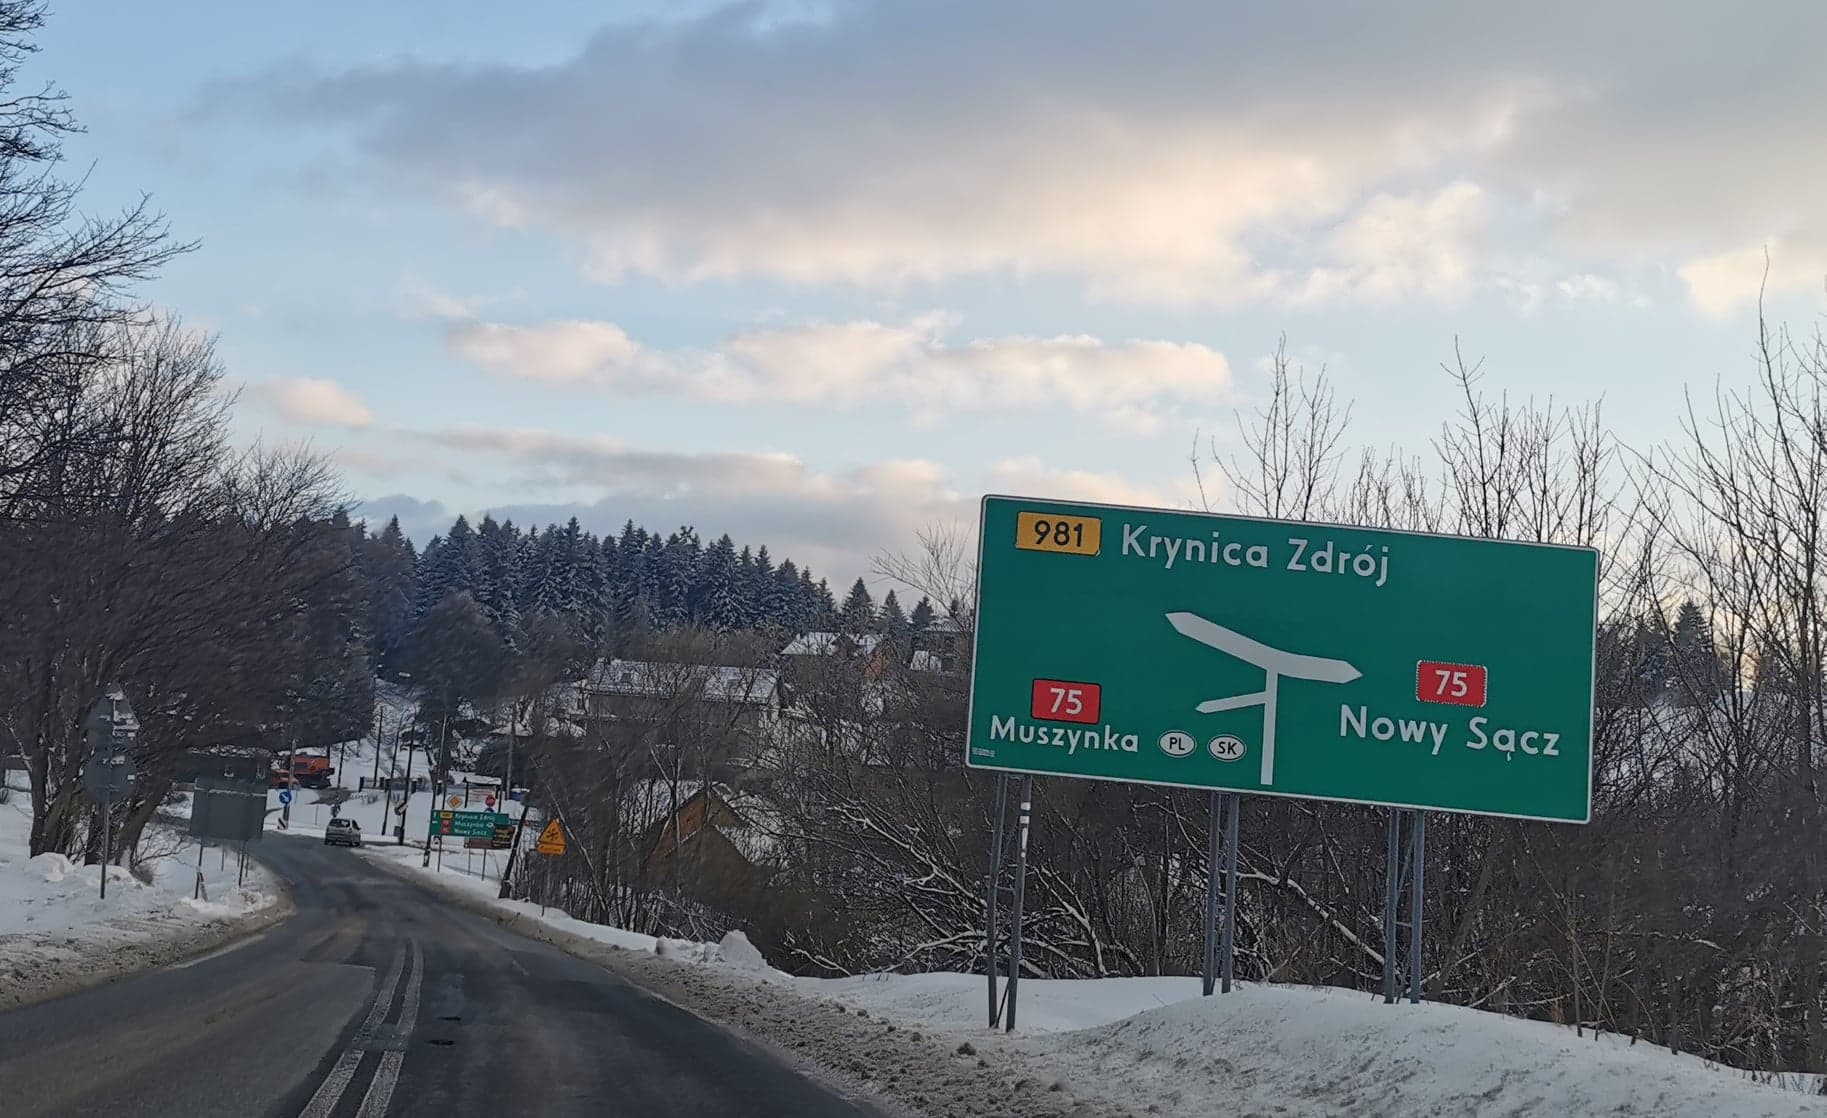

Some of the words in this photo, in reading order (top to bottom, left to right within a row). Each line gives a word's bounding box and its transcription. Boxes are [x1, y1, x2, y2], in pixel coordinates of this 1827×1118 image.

[1033, 519, 1084, 548] 981
[1122, 523, 1268, 569] Krynica
[1287, 538, 1388, 587] Zdrój
[1436, 669, 1468, 697] 75
[1050, 687, 1082, 715] 75
[990, 715, 1138, 755] Muszynka
[1168, 736, 1186, 752] PL
[1340, 704, 1448, 755] Nowy
[1466, 716, 1560, 761] Sącz
[1216, 740, 1238, 756] SK
